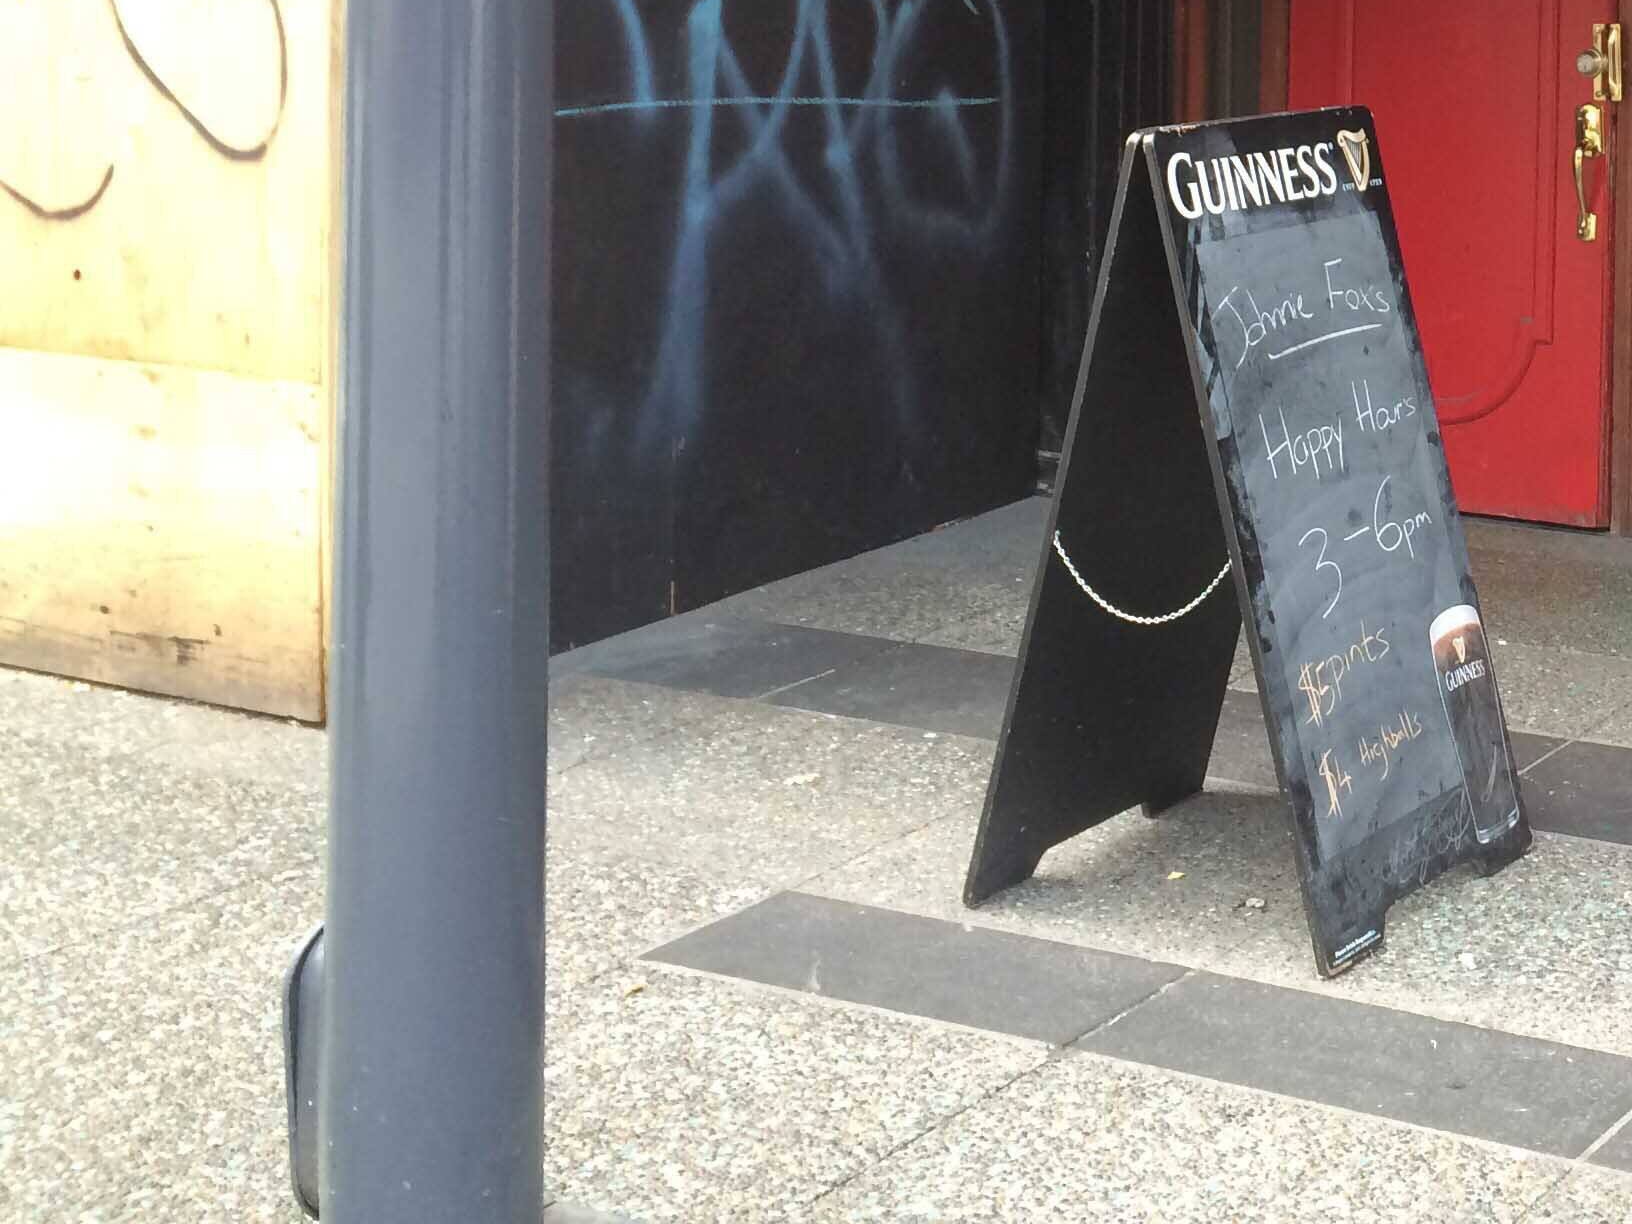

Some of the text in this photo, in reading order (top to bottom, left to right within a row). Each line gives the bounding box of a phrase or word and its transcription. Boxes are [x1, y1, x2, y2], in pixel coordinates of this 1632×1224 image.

[1166, 142, 1338, 219] GUINNESS
[1258, 407, 1345, 479] Happy
[1444, 659, 1486, 692] GUINNESS
